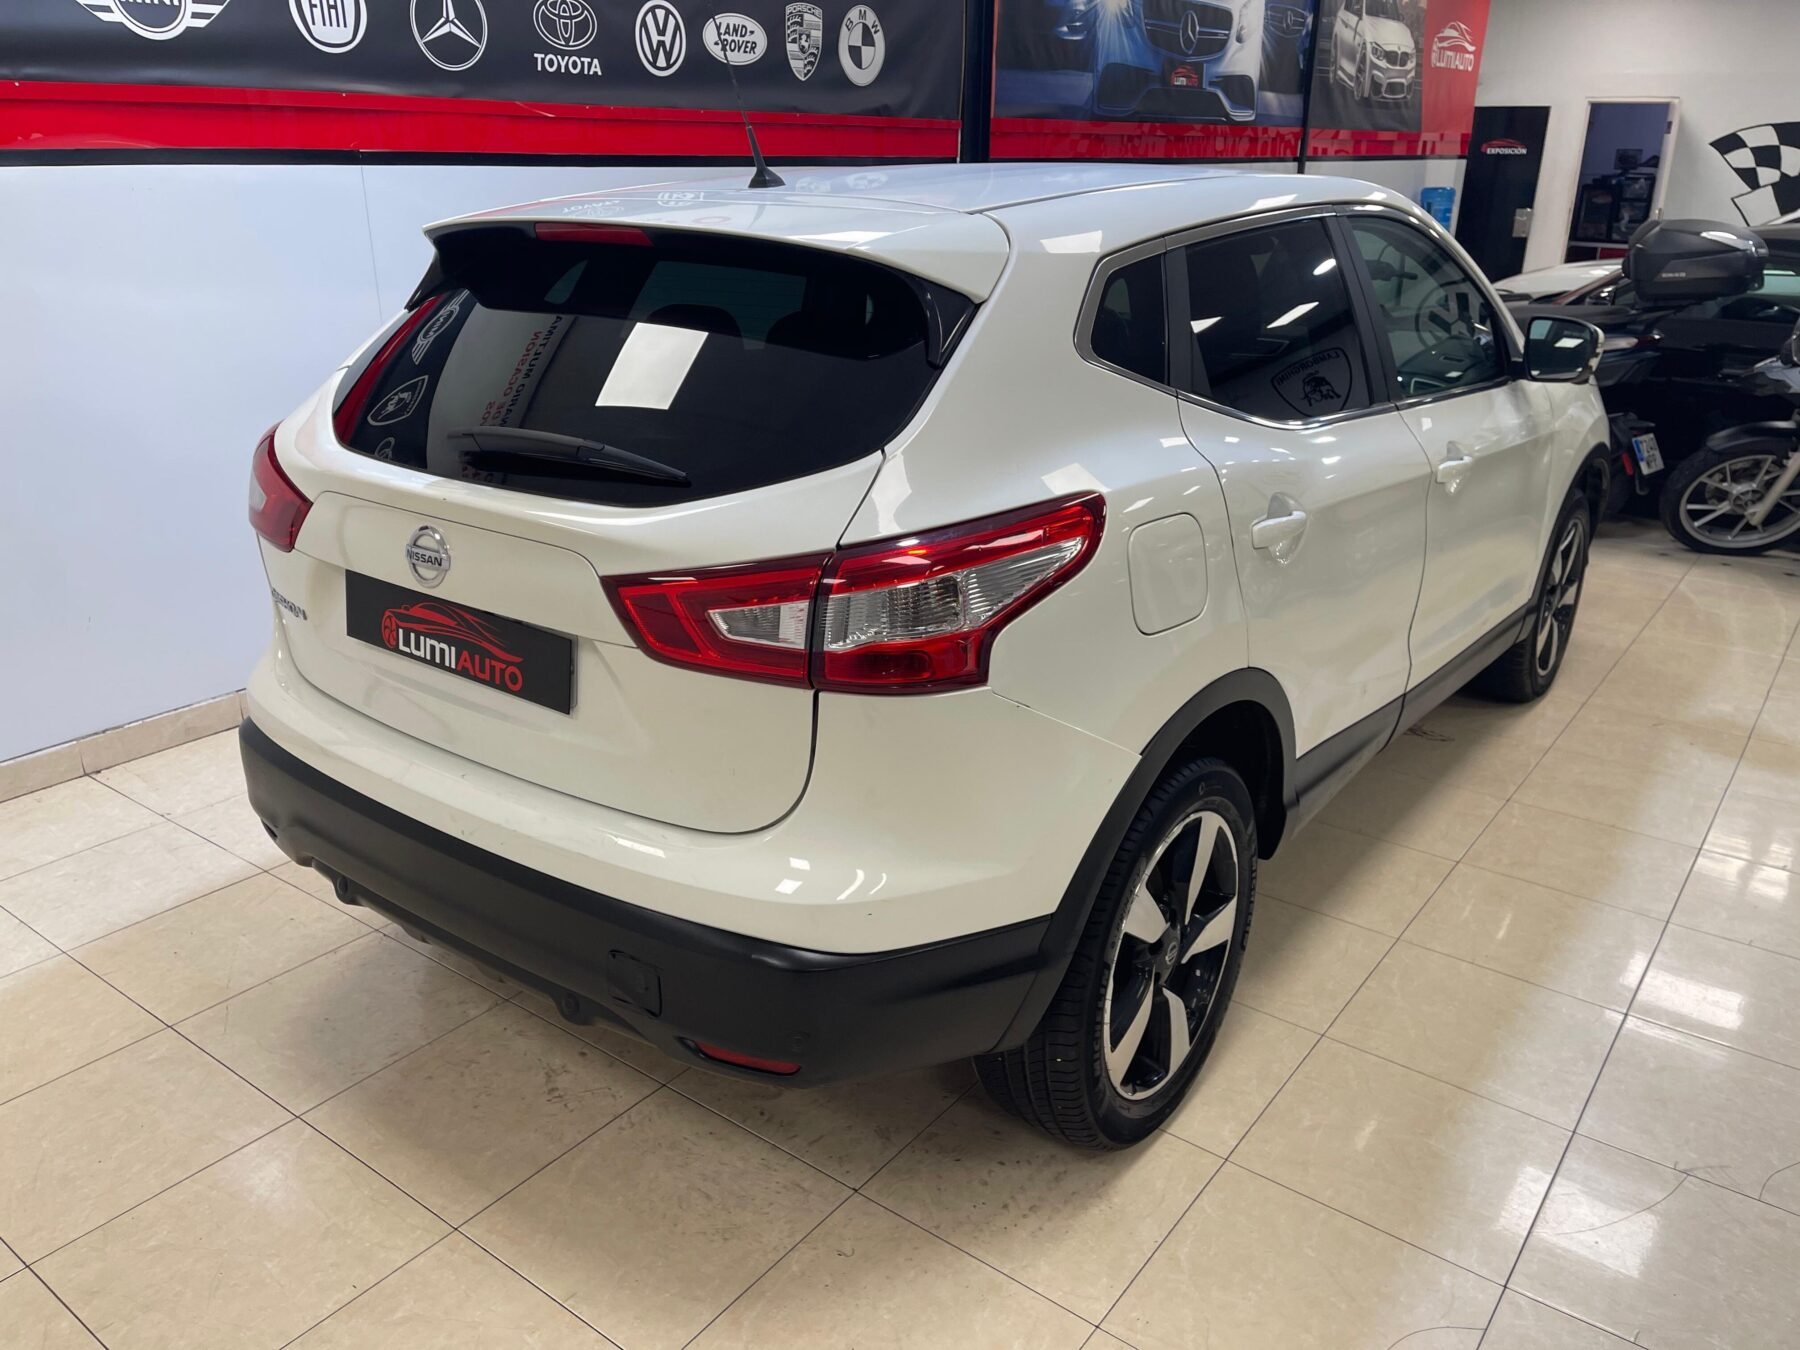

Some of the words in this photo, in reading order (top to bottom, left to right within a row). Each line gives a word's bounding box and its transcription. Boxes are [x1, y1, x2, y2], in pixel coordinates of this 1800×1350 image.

[787, 4, 823, 19] PORSCHE
[844, 9, 880, 35] BMW
[533, 53, 602, 76] TOYOTA
[406, 549, 443, 567] NISSAN
[398, 628, 524, 692] LUMIAUTO
